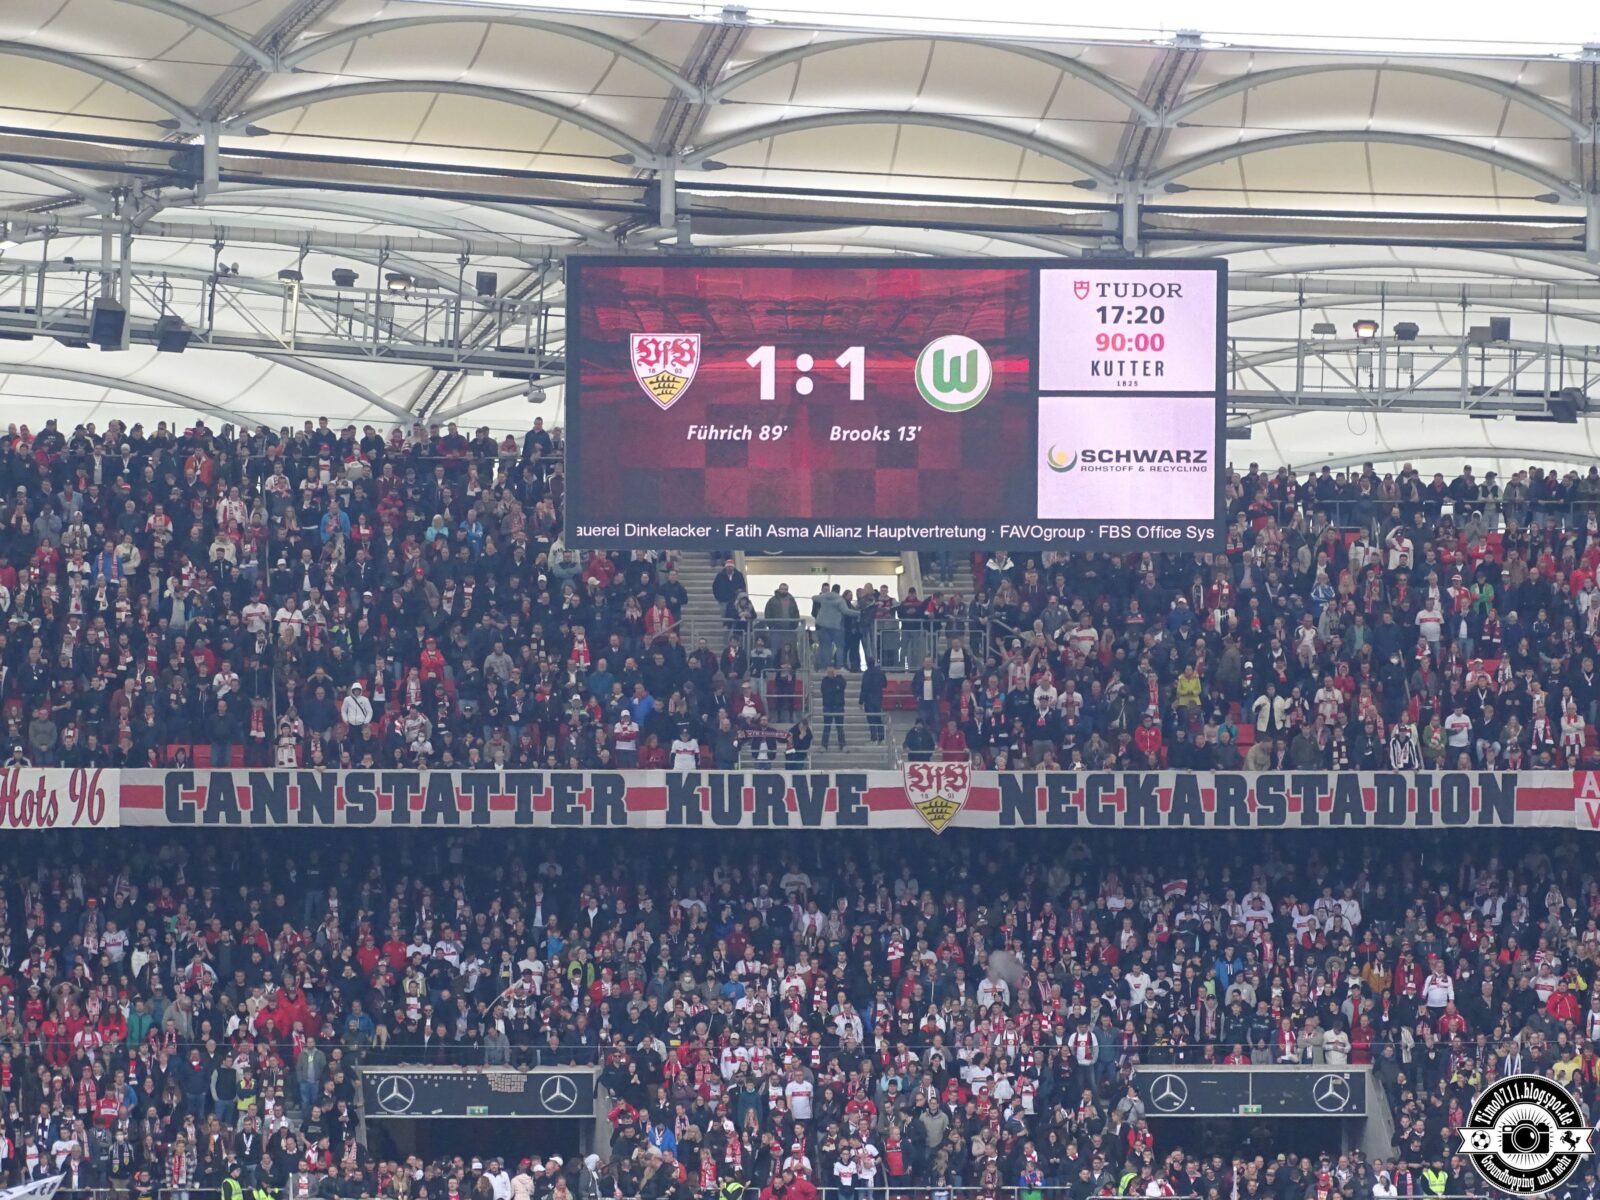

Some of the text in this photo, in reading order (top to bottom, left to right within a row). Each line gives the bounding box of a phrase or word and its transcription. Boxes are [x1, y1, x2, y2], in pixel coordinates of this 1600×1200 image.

[1096, 283, 1183, 298] TUDOR
[1096, 306, 1165, 325] 17:20
[1095, 333, 1165, 352] 90:00
[1091, 361, 1165, 377] KUTTER
[687, 424, 752, 441] Führich
[829, 426, 890, 442] Brooks
[1081, 450, 1208, 464] SCHWARZ
[1080, 465, 1208, 473] ROHSTOFF & RECYCLING
[624, 523, 712, 537] Dinkelacker
[725, 524, 762, 538] Fatih
[766, 524, 809, 538] Asma
[813, 524, 862, 538] Allianz
[867, 525, 986, 541] Hauptvertretung
[1000, 525, 1086, 542] FAVOgroup
[1099, 526, 1131, 539] FBS
[1136, 525, 1182, 539] Office
[1186, 526, 1215, 542] Sys
[69, 768, 106, 826] 96
[164, 771, 868, 826] CANNSTATTER KURVE
[999, 773, 1517, 826] NECKARSTADION
